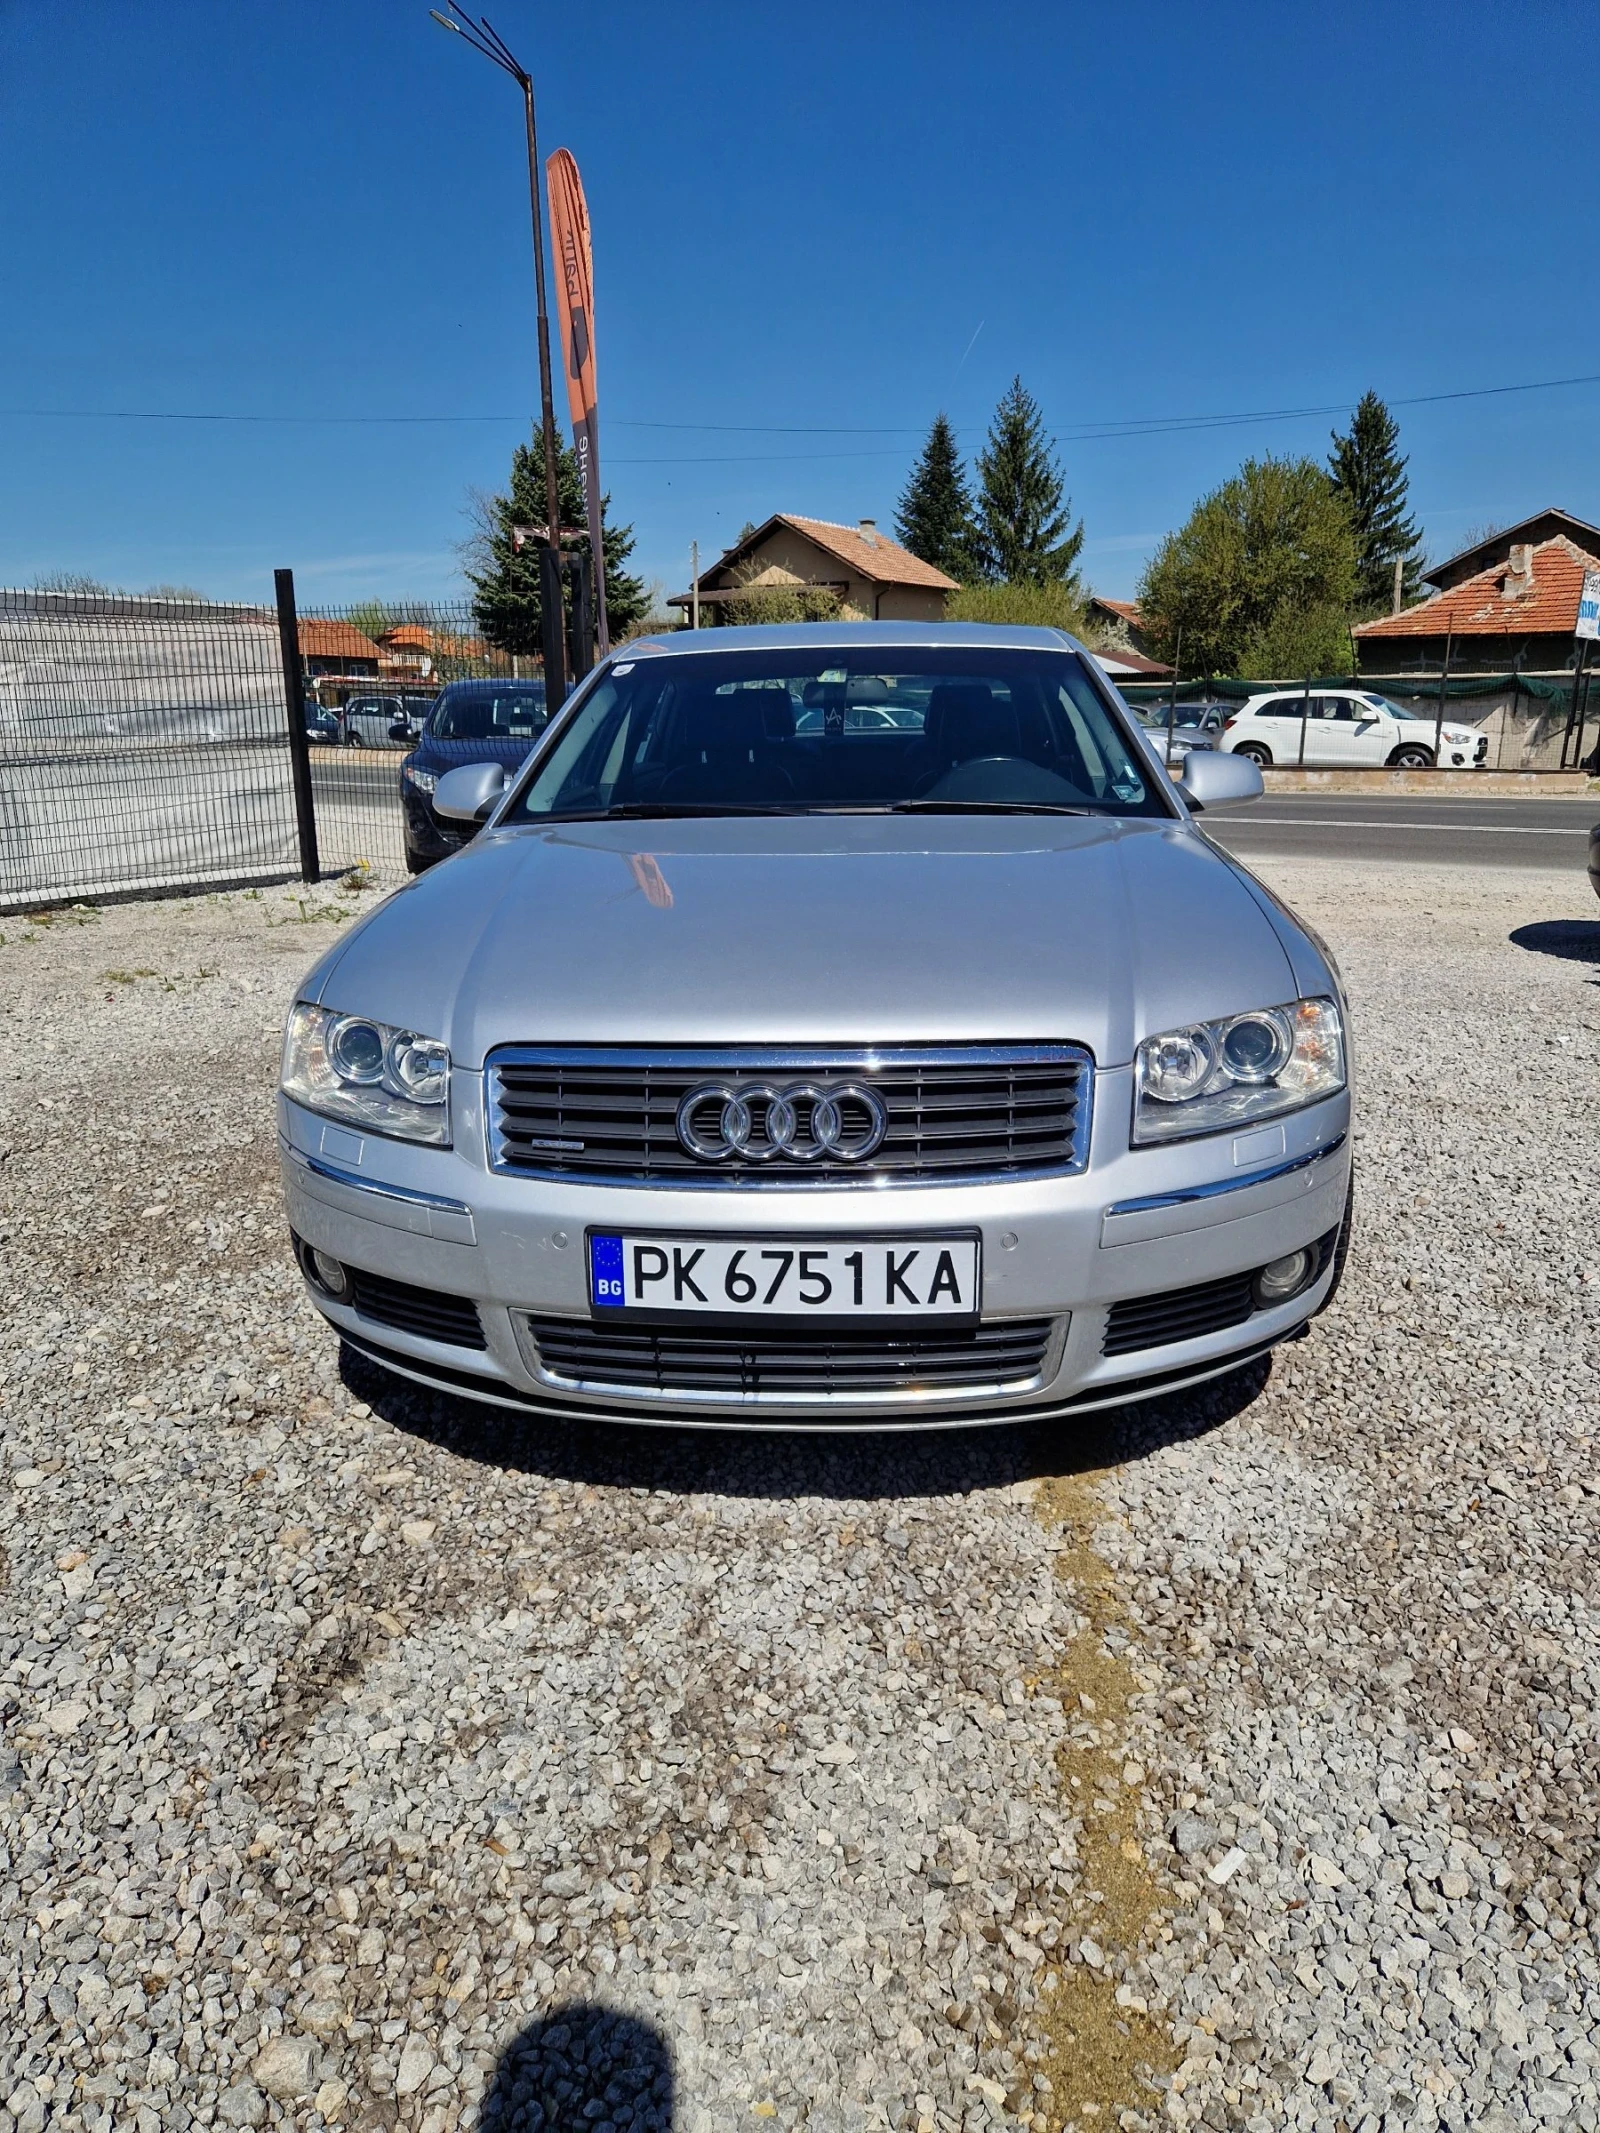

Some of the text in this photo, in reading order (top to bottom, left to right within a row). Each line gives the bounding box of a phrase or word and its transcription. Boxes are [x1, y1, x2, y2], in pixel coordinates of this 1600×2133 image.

[598, 1279, 622, 1296] BG
[633, 1246, 962, 1306] PK 6751 KA
